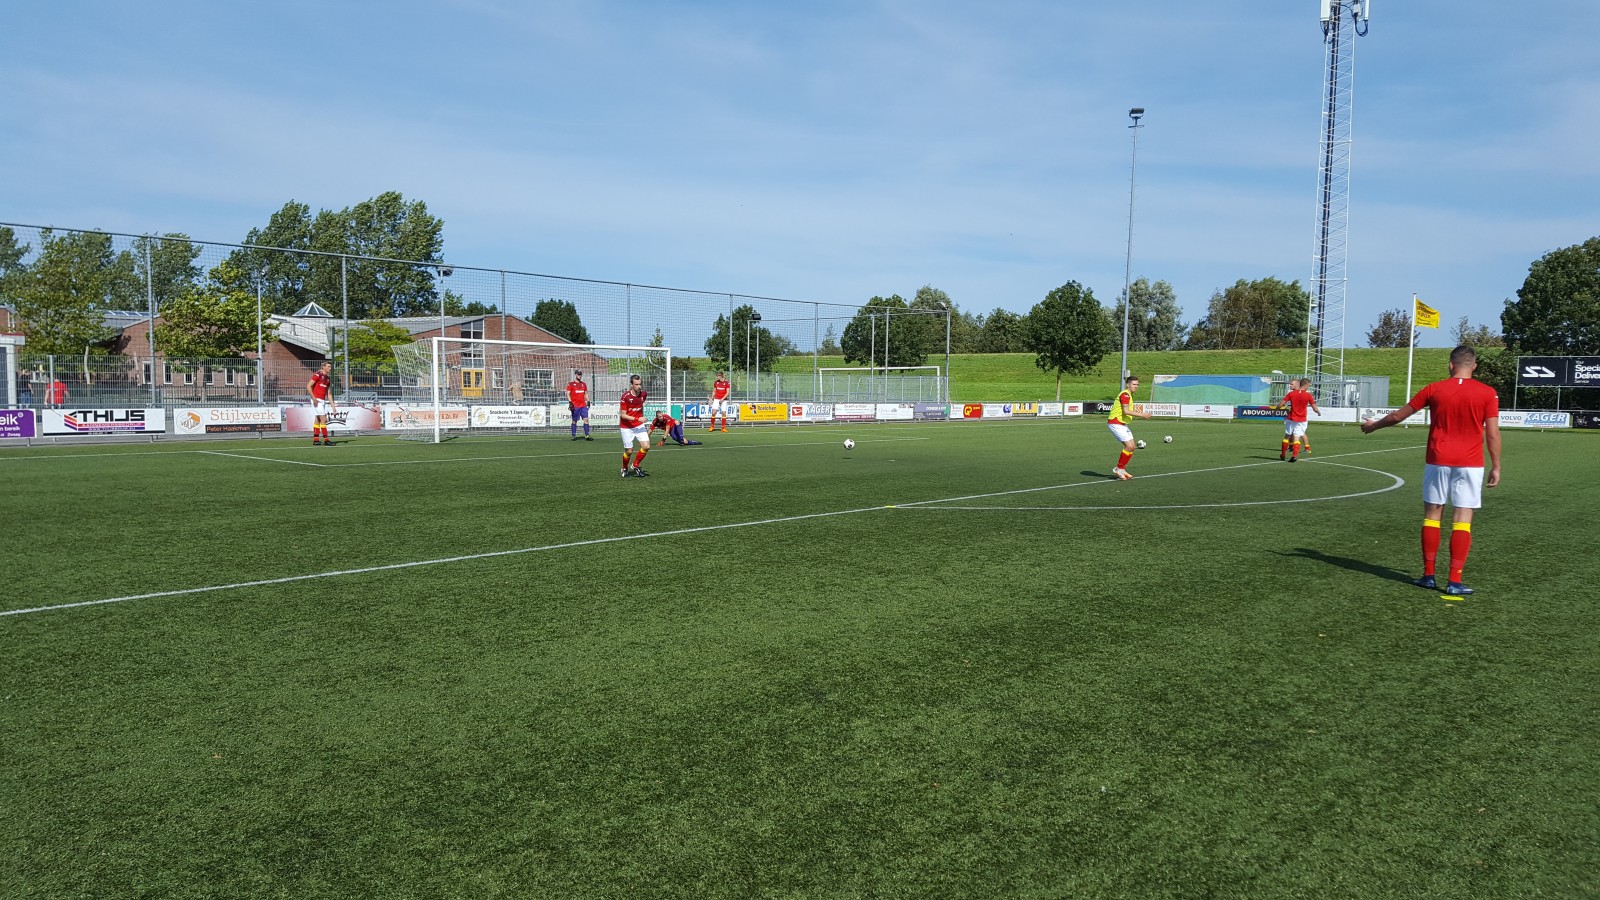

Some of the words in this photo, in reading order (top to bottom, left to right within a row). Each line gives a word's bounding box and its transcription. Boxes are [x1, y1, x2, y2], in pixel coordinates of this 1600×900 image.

[807, 405, 830, 414] KAGER
[77, 410, 145, 422] THIJS
[210, 409, 276, 423] Stijlwerk
[1525, 414, 1566, 422] KAGER
